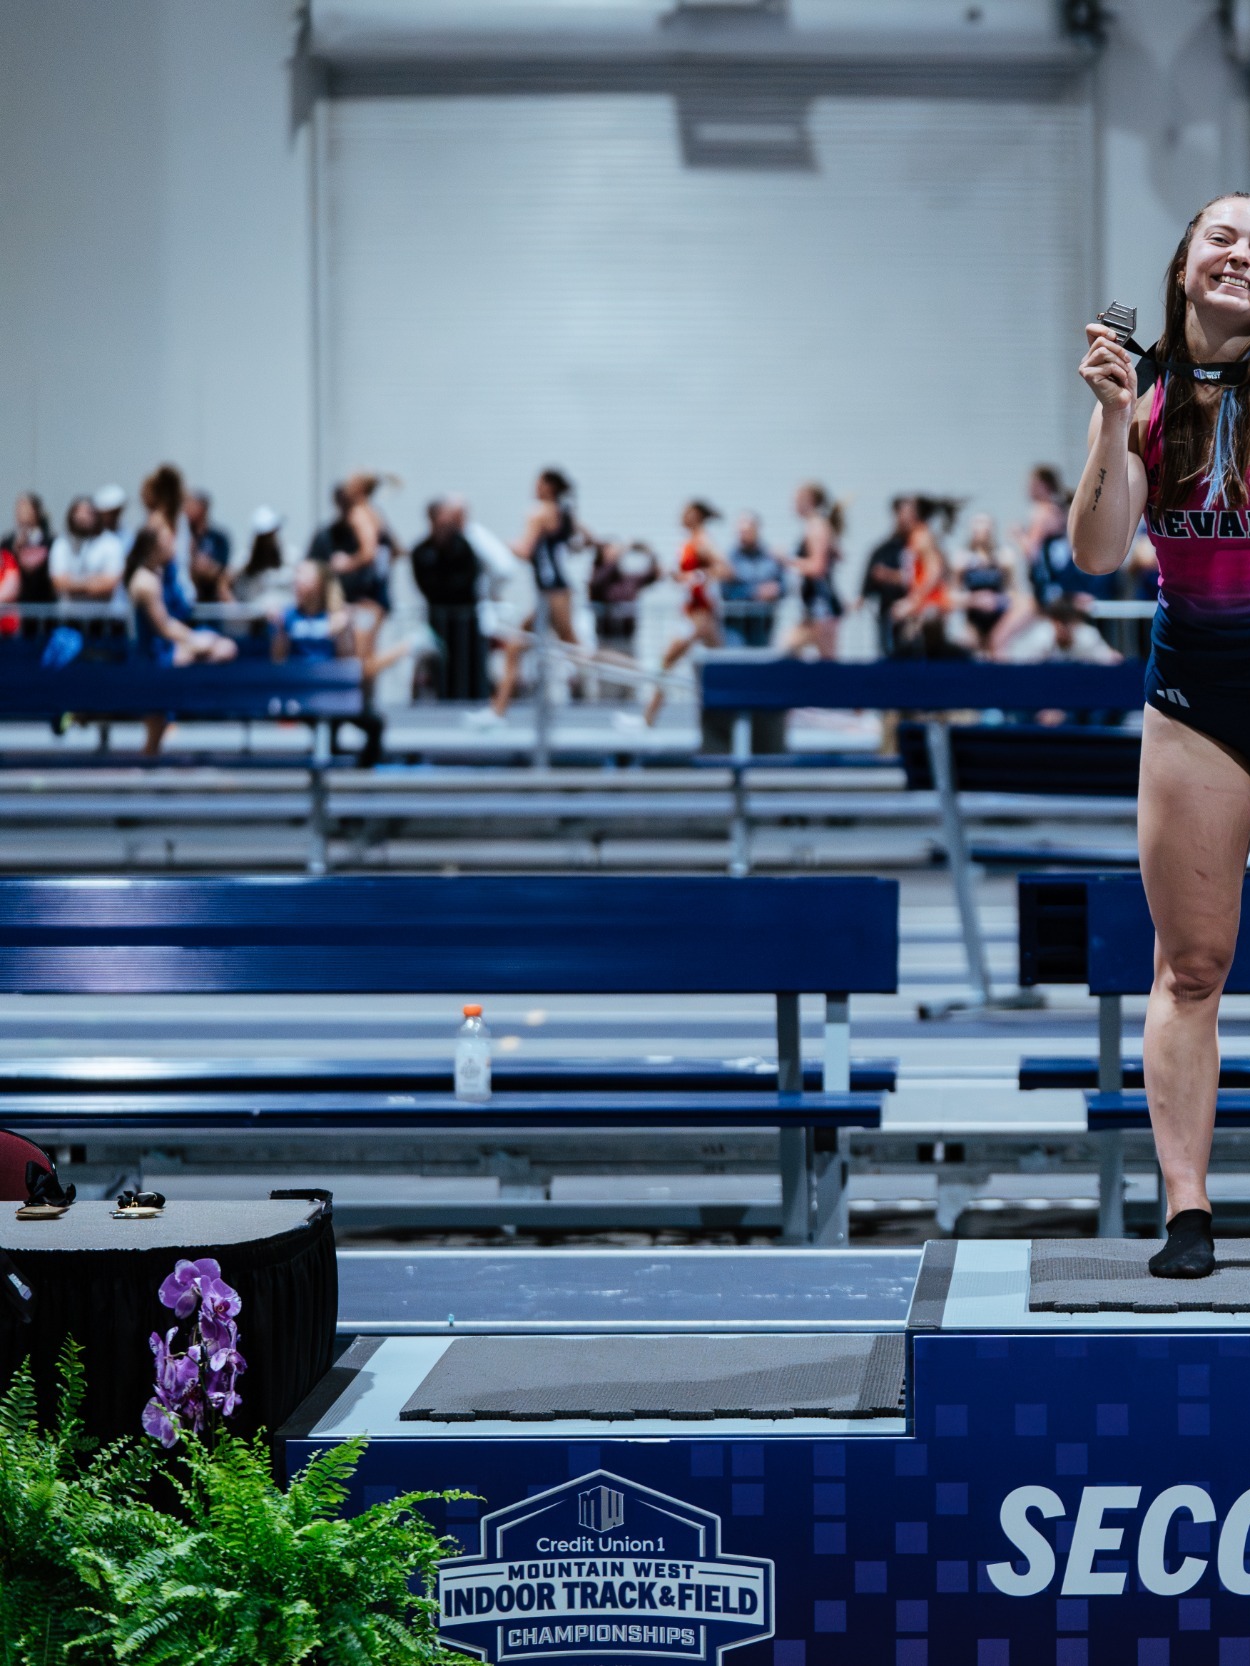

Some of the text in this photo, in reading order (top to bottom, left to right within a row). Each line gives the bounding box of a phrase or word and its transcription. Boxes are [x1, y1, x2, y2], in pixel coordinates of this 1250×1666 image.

[536, 1536, 594, 1552] Credit
[508, 1561, 695, 1581] MOUNTAIN WEST
[444, 1582, 556, 1618] INDOOR
[508, 1624, 695, 1647] CHAMPIONSHIPS
